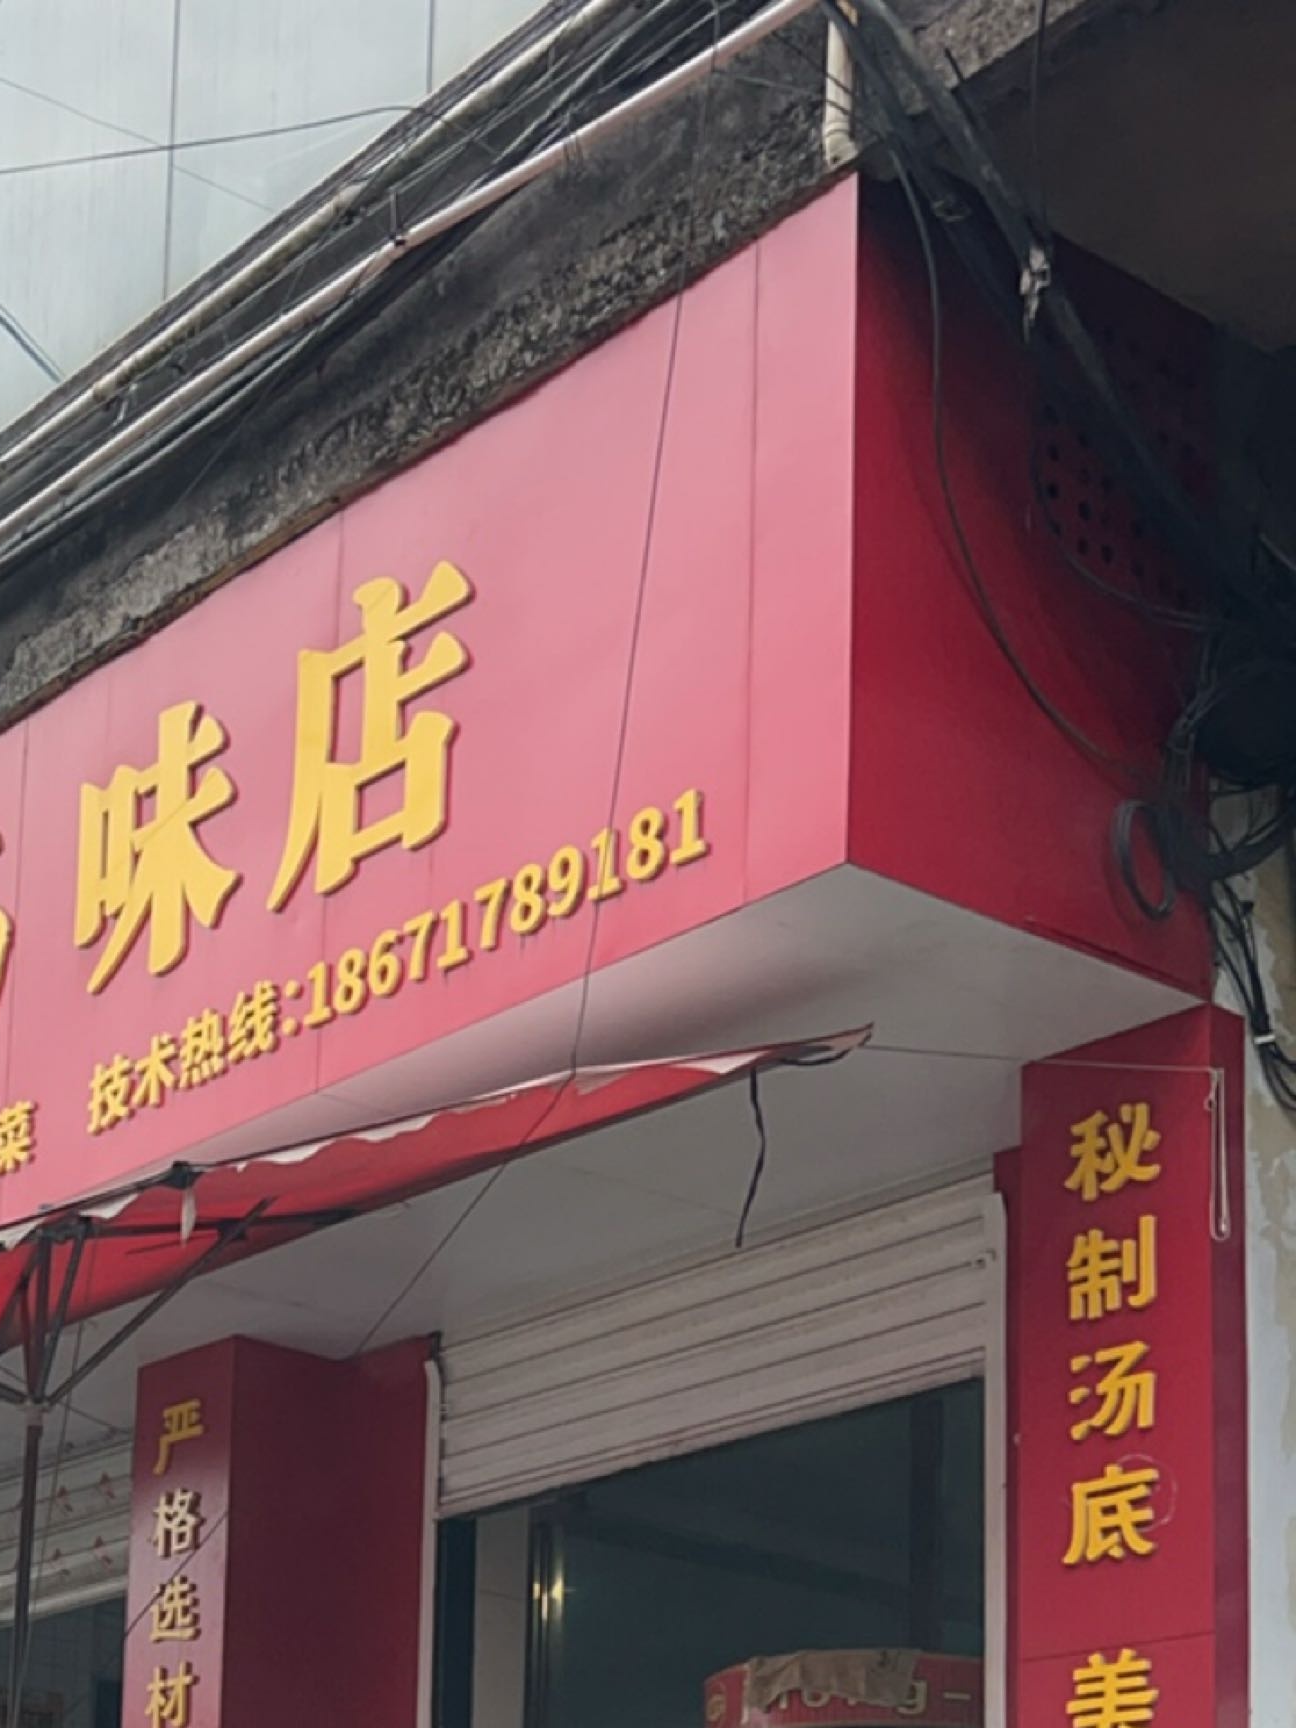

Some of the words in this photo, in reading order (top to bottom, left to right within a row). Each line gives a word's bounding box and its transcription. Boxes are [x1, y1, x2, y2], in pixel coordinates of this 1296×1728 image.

[86, 789, 709, 1133] 技术热线:18671789181
[1062, 1105, 1161, 1567] 秘制汤底
